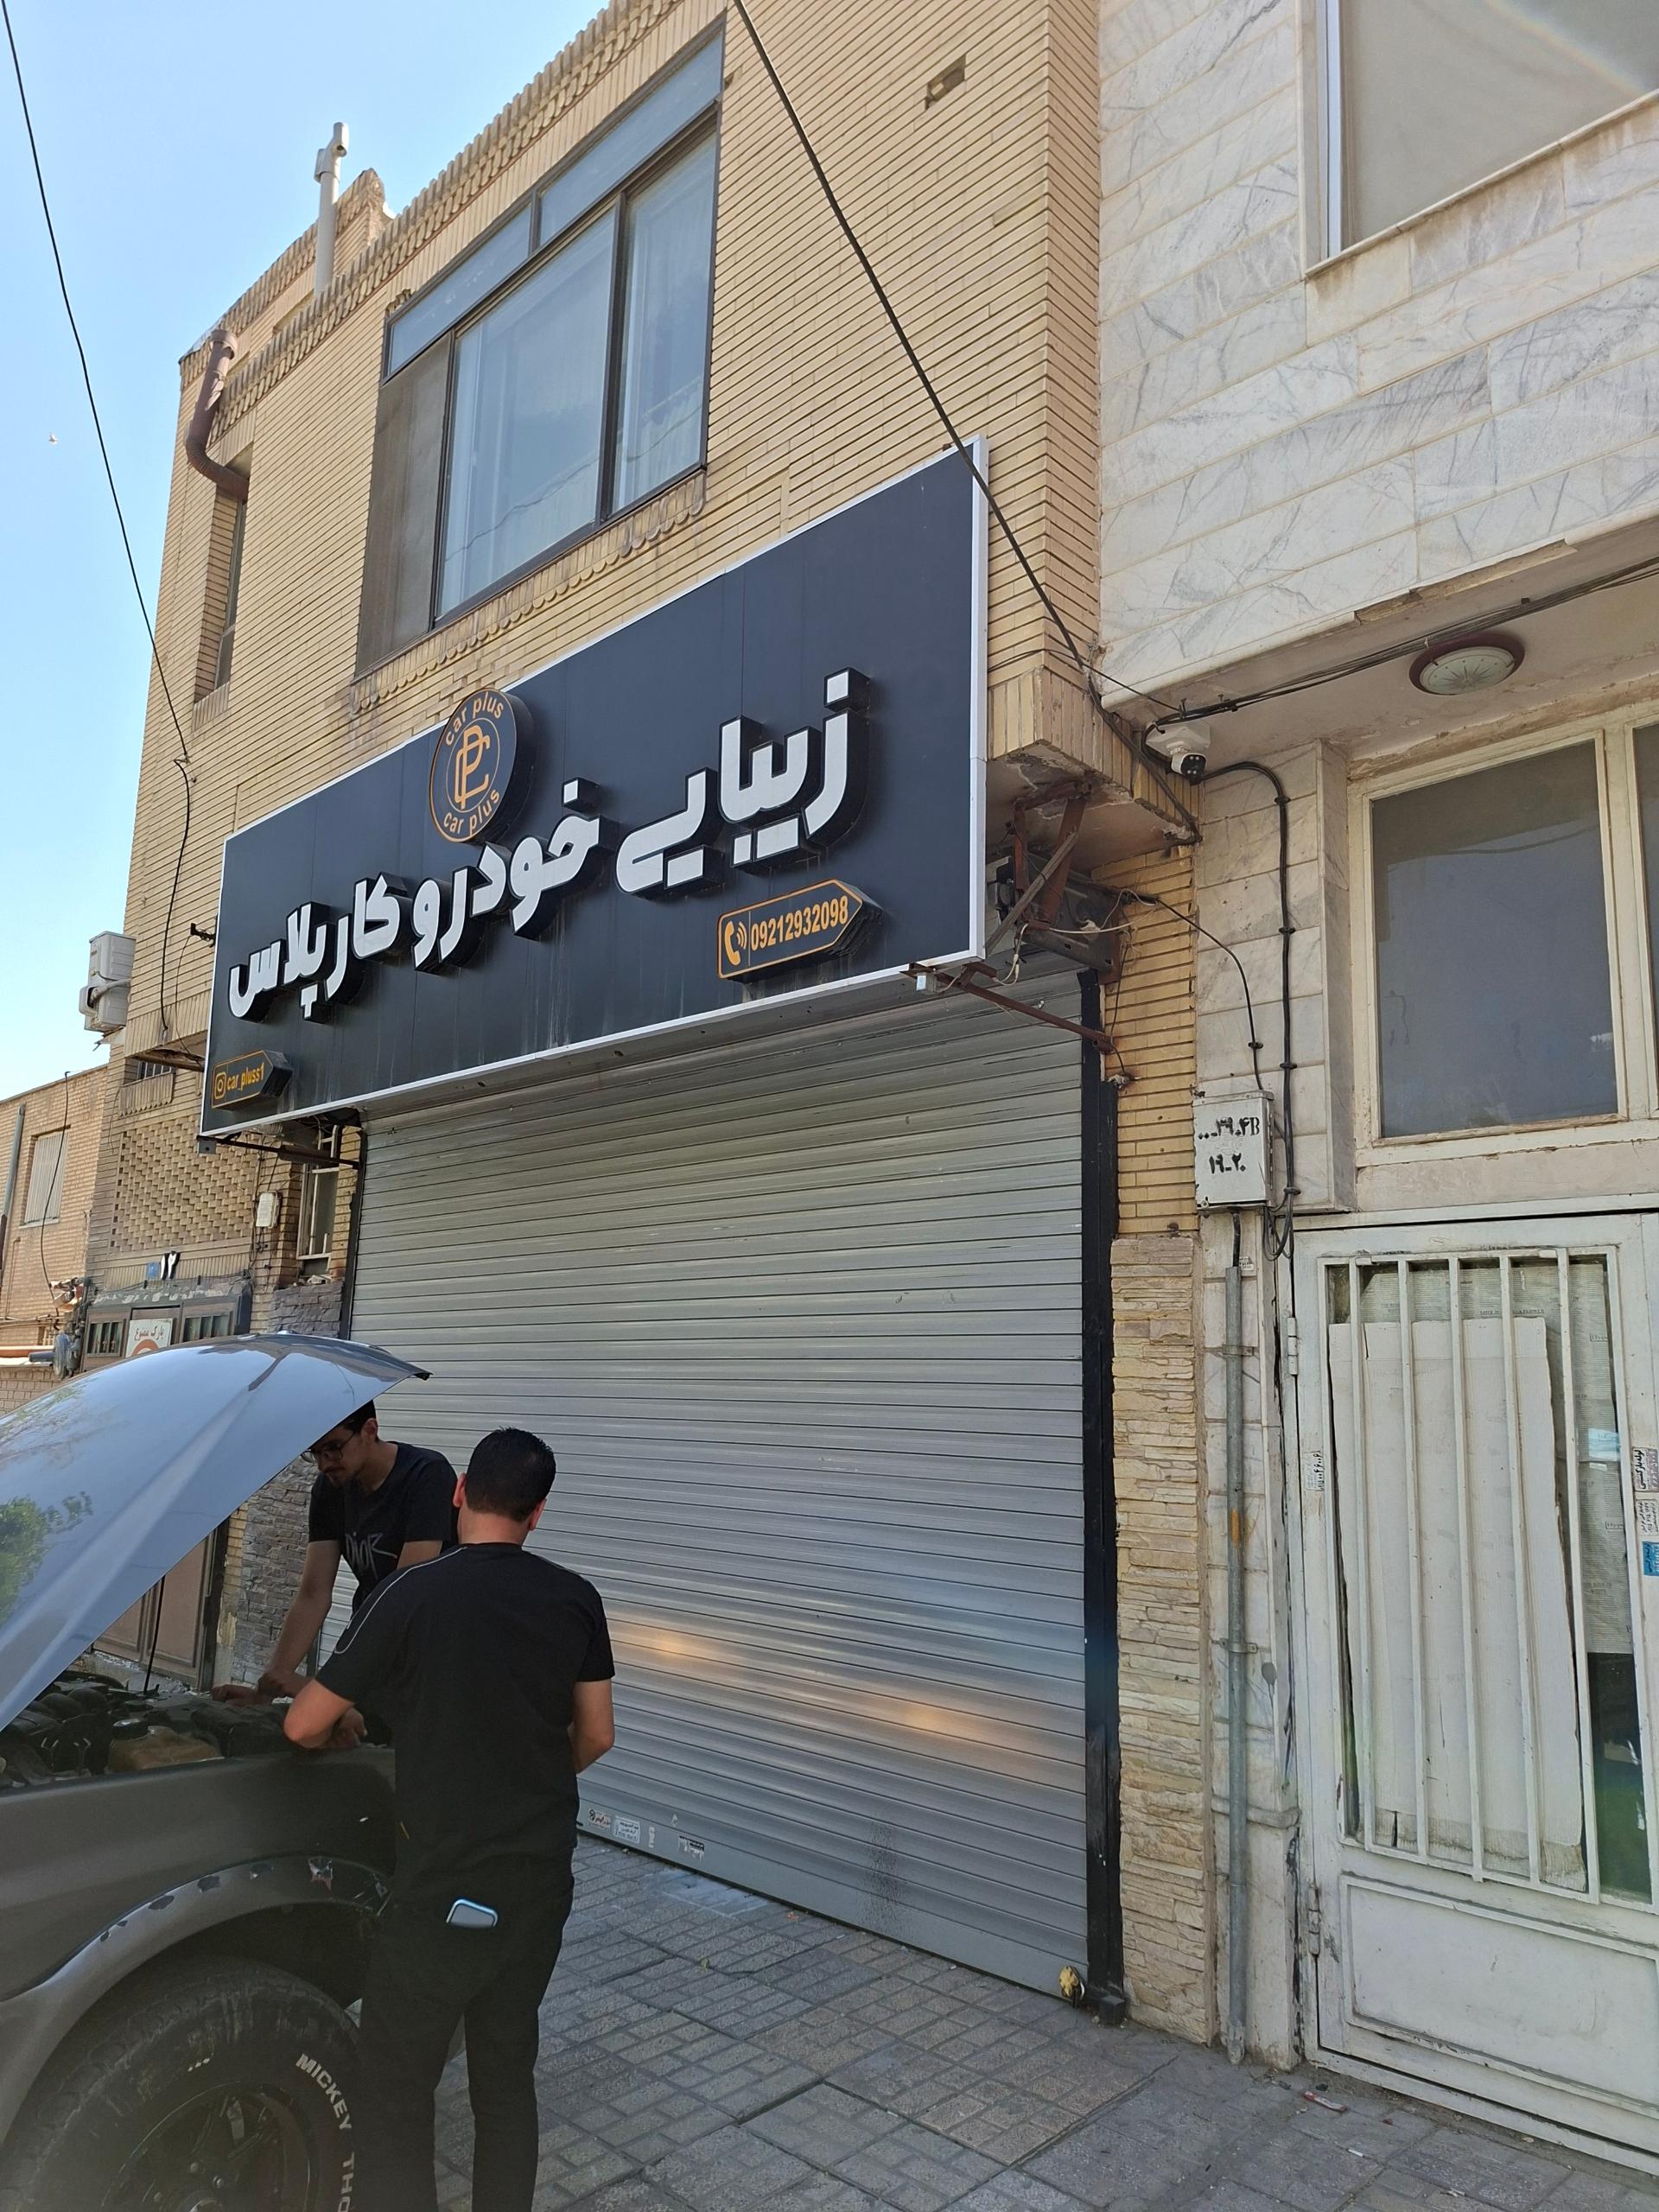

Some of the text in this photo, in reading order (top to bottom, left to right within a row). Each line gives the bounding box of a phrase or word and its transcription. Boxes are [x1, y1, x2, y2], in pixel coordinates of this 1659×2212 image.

[445, 691, 505, 747] car plus
[443, 789, 500, 836] car plus
[411, 777, 602, 969] خودرو
[750, 894, 849, 951] 09212932098
[226, 1061, 265, 1092] car_pluss1
[296, 2052, 353, 2131] MICKEY
